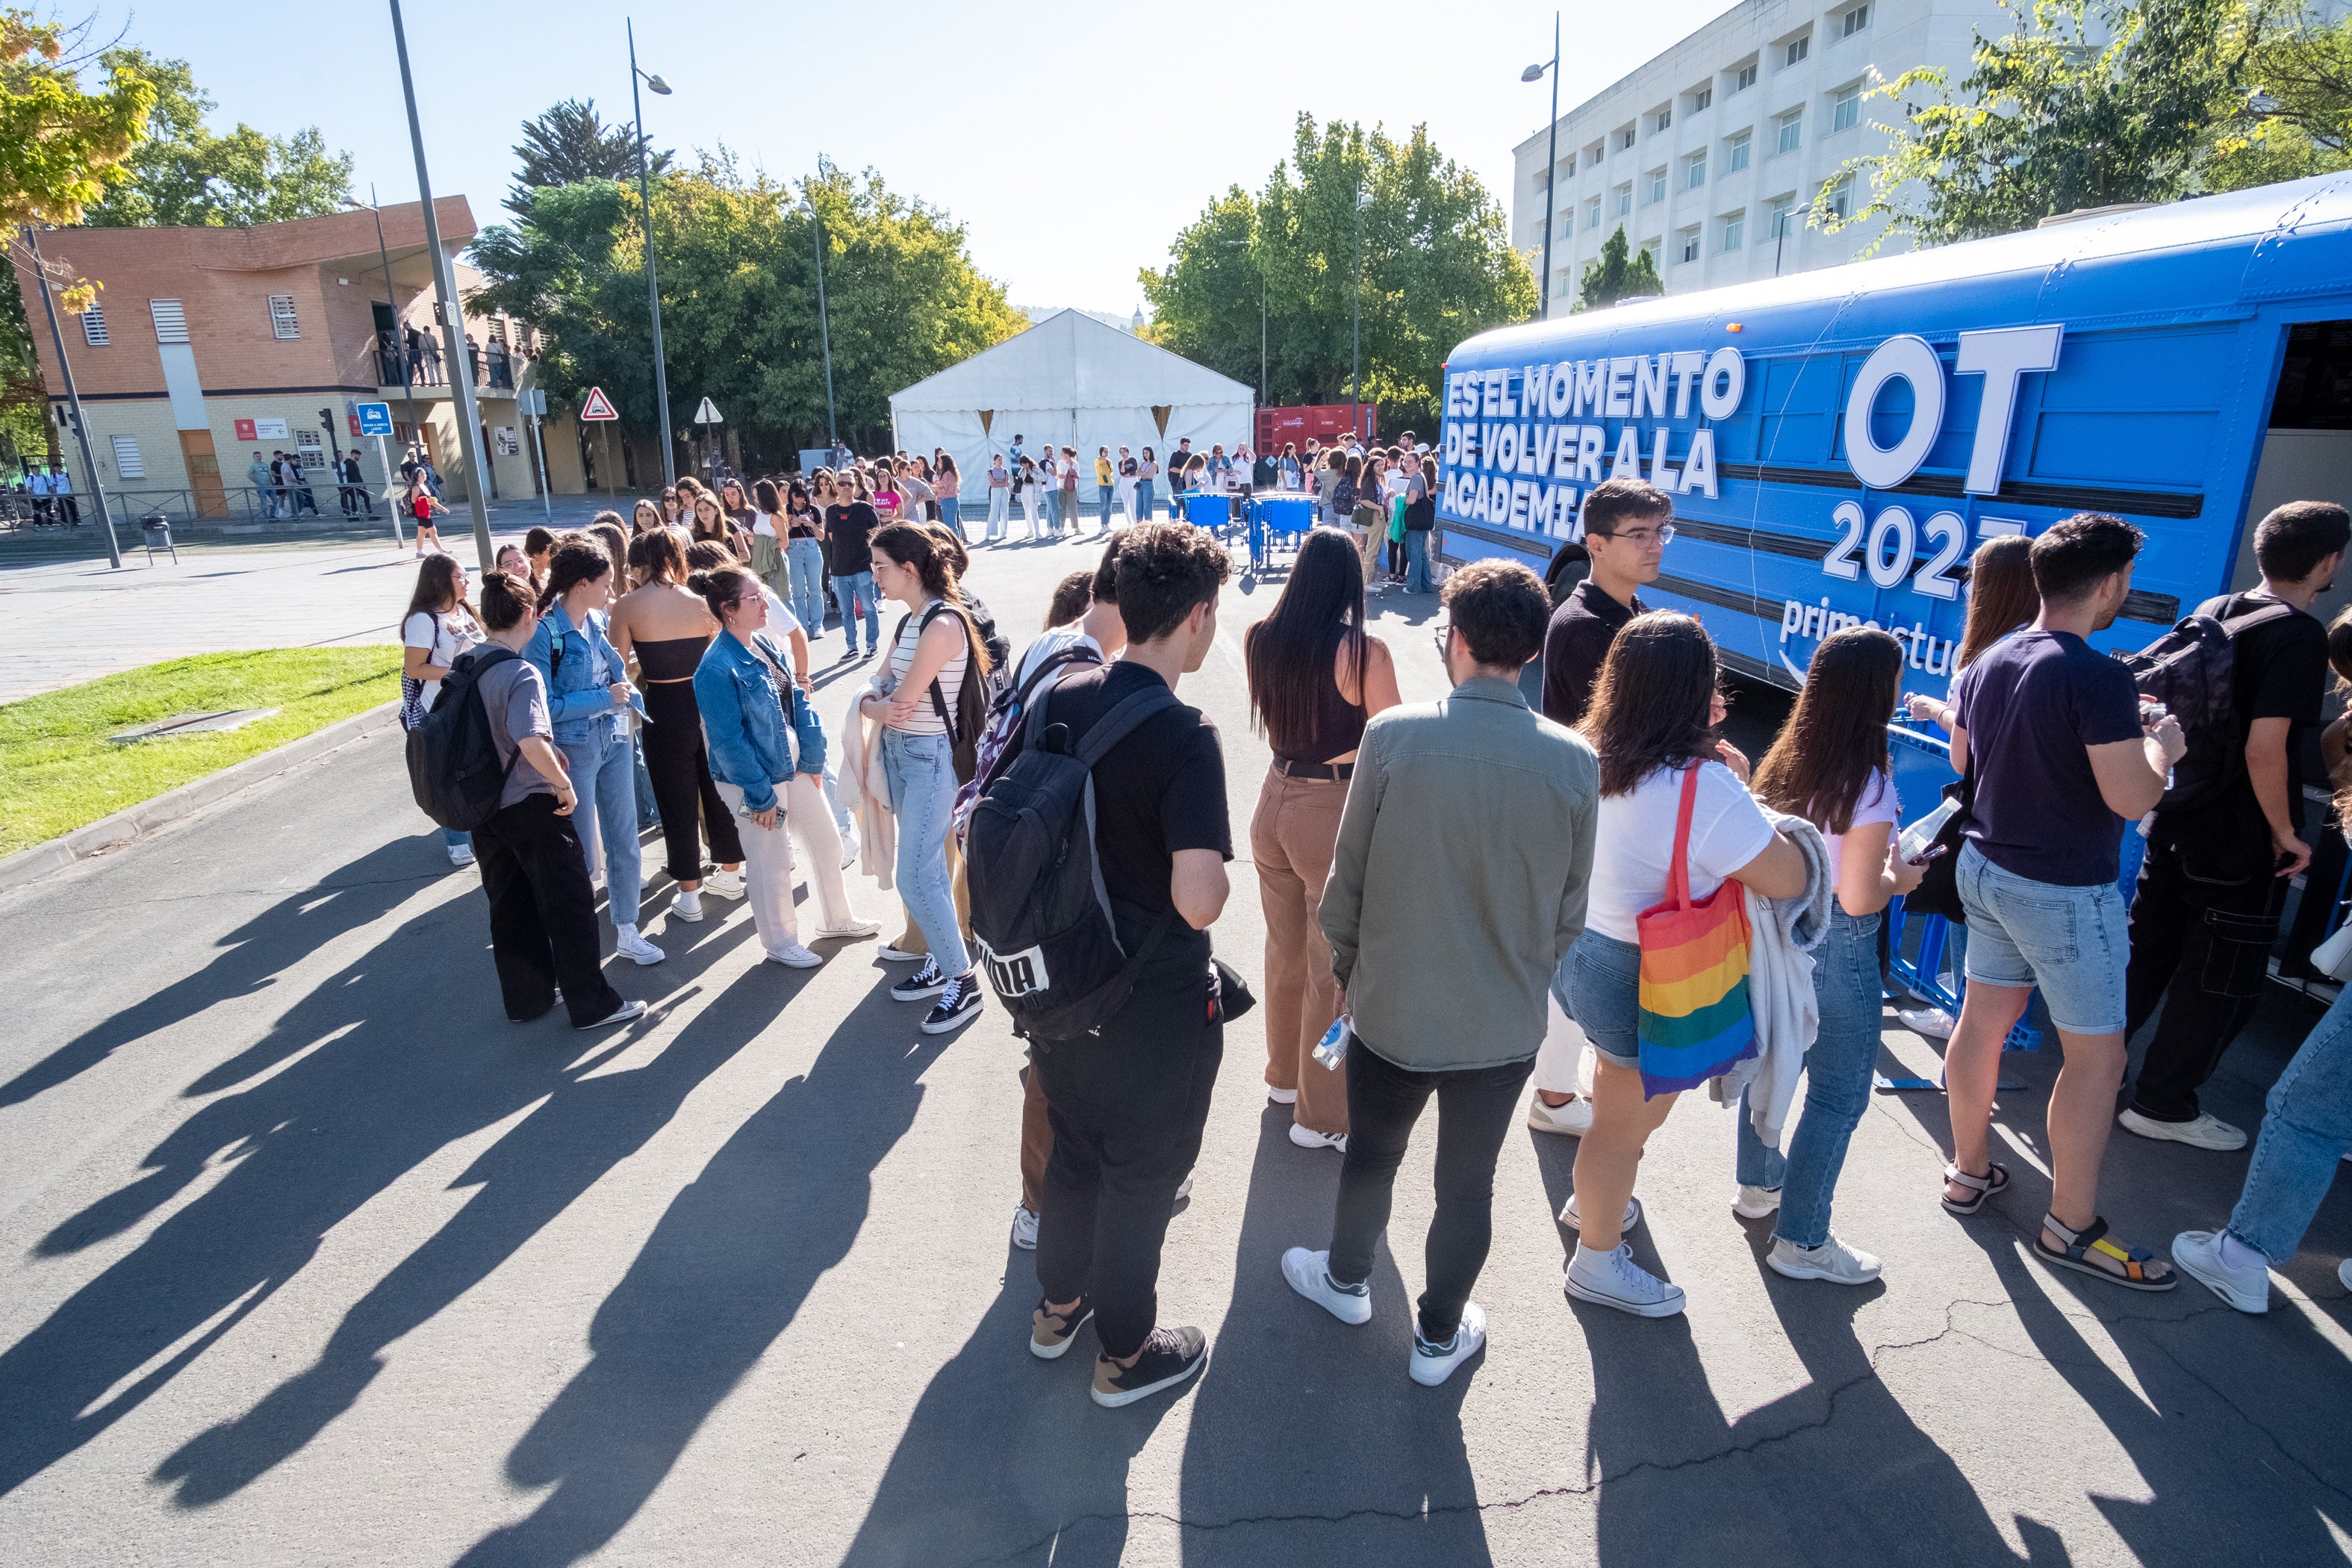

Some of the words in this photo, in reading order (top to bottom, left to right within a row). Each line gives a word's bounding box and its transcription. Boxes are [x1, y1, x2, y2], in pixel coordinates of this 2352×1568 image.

[1447, 370, 1479, 418] ES
[1483, 367, 1516, 418] EL
[1521, 346, 1746, 421] MOMENTO
[1844, 323, 2065, 497] OT
[1445, 422, 1478, 469] DE
[1481, 423, 1606, 484] VOLVER
[1609, 426, 1641, 480] A
[1651, 426, 1720, 500] LA
[1779, 597, 1881, 643] prim
